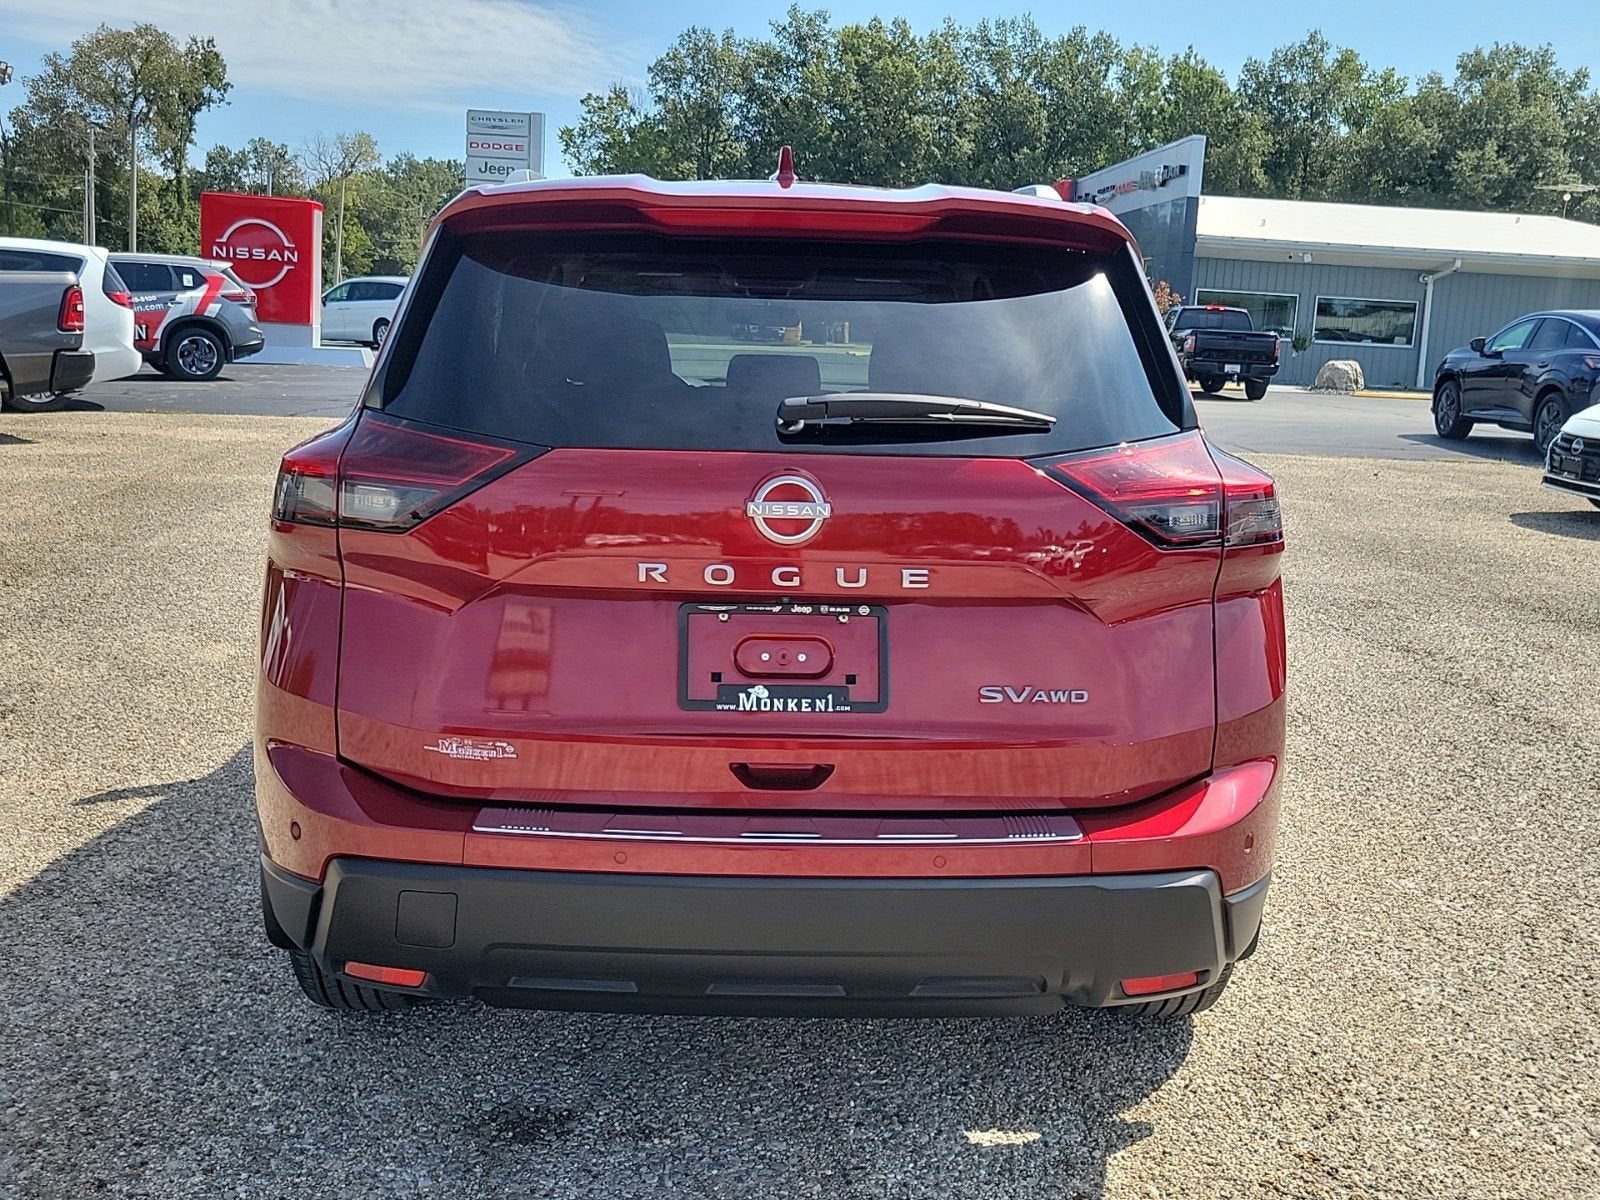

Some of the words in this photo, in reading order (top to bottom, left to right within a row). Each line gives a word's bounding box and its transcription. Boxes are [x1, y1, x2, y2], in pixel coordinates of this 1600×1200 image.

[470, 116, 524, 124] CHRYSLER
[469, 141, 525, 152] DODGE
[478, 161, 515, 177] Jeep
[212, 245, 298, 263] NISSAN
[749, 504, 829, 516] NISSAN
[637, 562, 930, 589] ROGUE
[790, 604, 813, 614] Jeep
[979, 686, 1032, 703] SV
[1031, 690, 1089, 703] AWD
